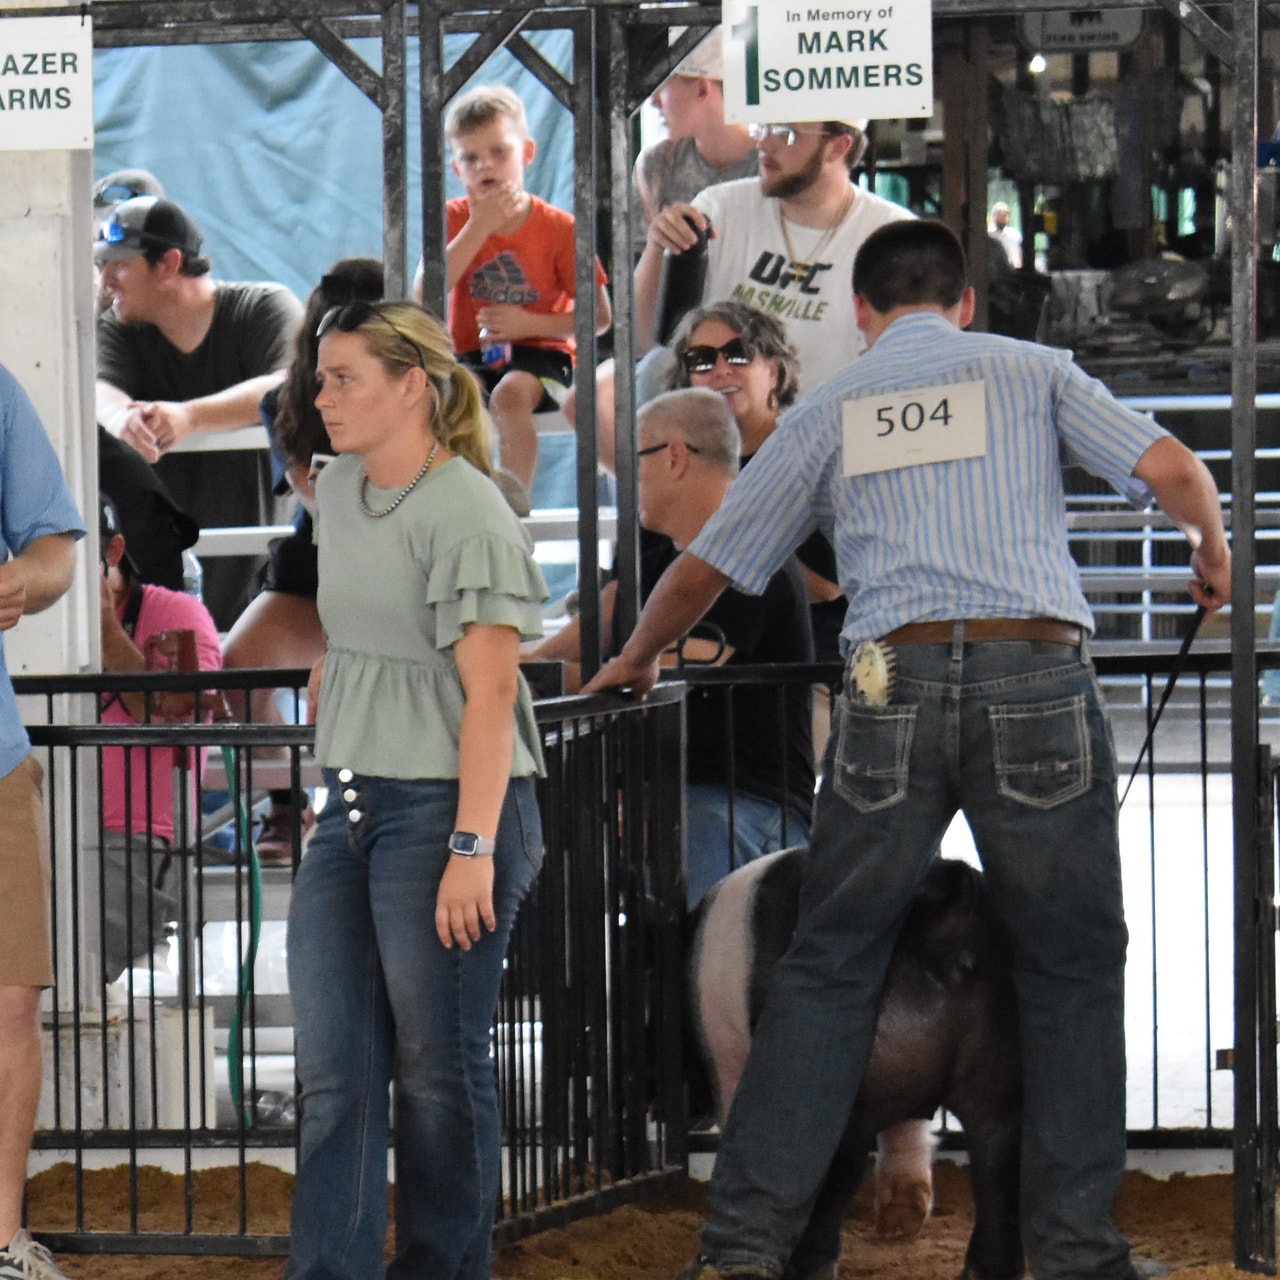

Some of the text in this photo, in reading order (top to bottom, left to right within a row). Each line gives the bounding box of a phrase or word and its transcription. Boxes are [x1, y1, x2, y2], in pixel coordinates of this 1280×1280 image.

[786, 6, 894, 22] In Memory of
[731, 6, 760, 106] 1
[797, 28, 888, 54] MARK
[763, 63, 924, 92] SOMMERS
[748, 250, 833, 295] UFC
[876, 398, 953, 437] 504
